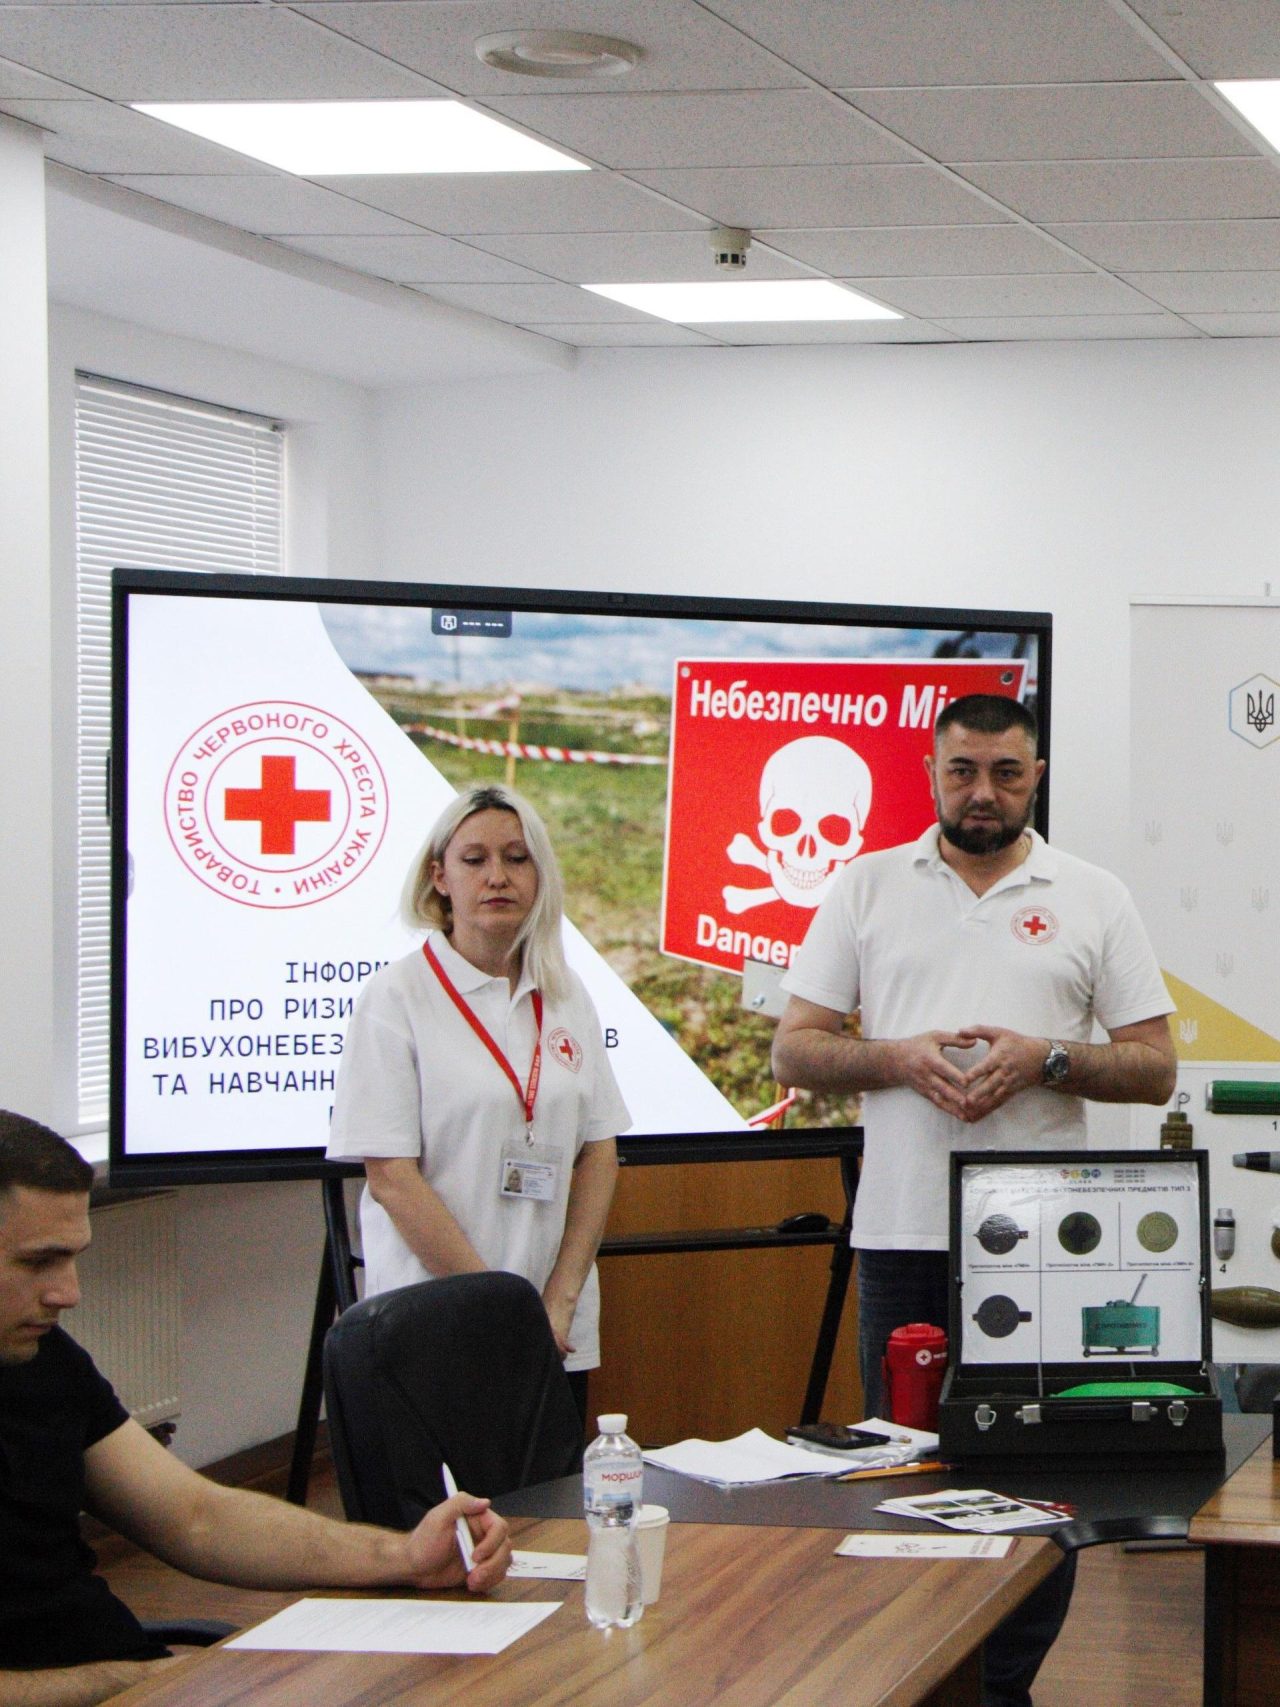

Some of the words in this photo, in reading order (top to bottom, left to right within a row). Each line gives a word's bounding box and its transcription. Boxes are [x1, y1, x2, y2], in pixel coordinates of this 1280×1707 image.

[690, 679, 888, 727] Небезпечно
[898, 684, 958, 729] Мі
[193, 712, 329, 761] ЧЕРВОНОГО
[333, 738, 377, 819] ХРЕСТА
[177, 771, 261, 895] ТОВАРИСТВО
[294, 828, 372, 896] УКРАЇНИ
[210, 998, 263, 1021] ПРО
[152, 1073, 188, 1096] ТА
[1272, 1121, 1277, 1131] 1
[1219, 1264, 1227, 1273] 4
